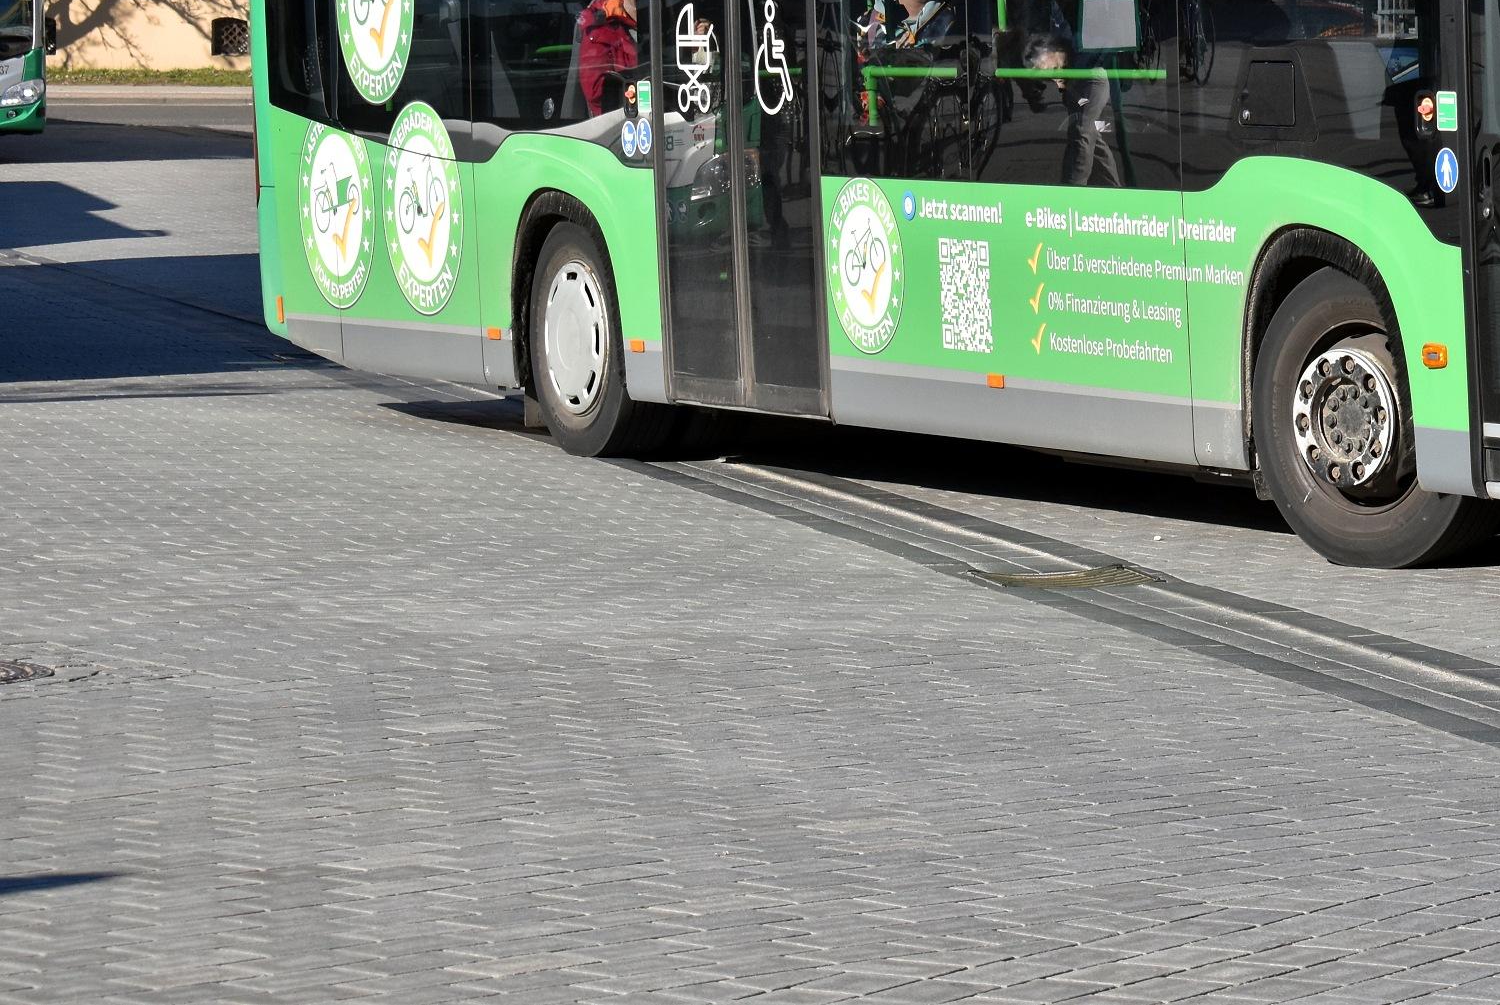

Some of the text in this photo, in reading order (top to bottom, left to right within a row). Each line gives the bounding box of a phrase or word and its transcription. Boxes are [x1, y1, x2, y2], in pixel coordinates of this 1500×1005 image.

[349, 50, 403, 97] EXPERTEN
[388, 110, 433, 169] DREIRÄDER
[833, 183, 895, 232] E-BIKES VOM
[919, 196, 1003, 224] Jetzt scannen!
[1025, 207, 1067, 232] e-Bikes
[1075, 213, 1169, 239] Lastenfahrräder
[1178, 218, 1237, 243] Dreiräder
[314, 258, 366, 297] VOM EXPERTEN
[400, 260, 454, 307] EXPERTEN
[1046, 247, 1244, 286] Über 16 verschiedene Premium Marken
[841, 308, 896, 349] EXPERTEN
[1048, 291, 1181, 327] 0% Finanzierung & Leasing
[1049, 331, 1173, 363] Kostenlose Probefahrten
